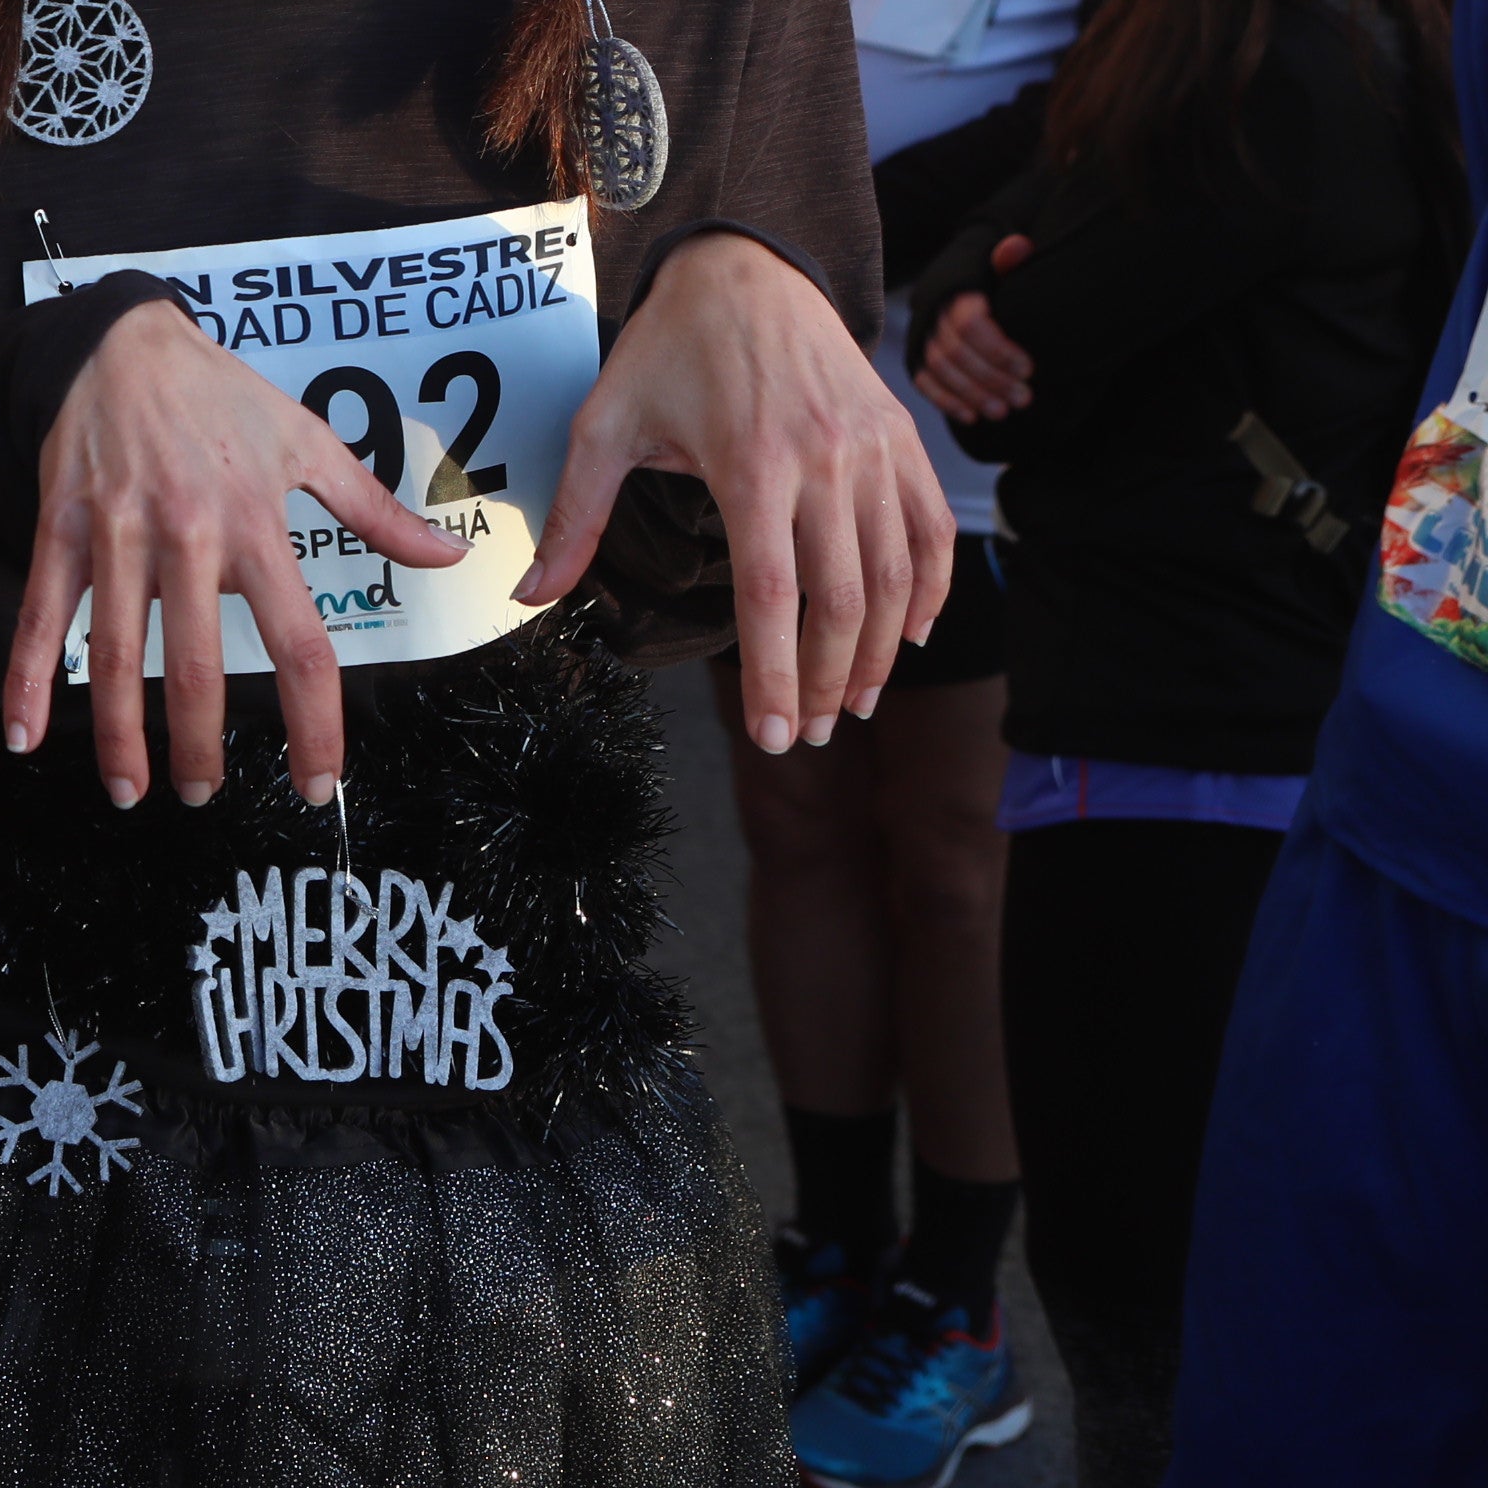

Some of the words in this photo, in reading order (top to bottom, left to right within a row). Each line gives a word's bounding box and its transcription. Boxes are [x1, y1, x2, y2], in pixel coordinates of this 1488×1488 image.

[232, 225, 565, 302] SILVESTRE
[331, 292, 410, 341] DE
[425, 261, 567, 330] CÁDIZ
[300, 350, 508, 508] 92
[235, 865, 454, 987] MERRY
[192, 966, 515, 1091] CHRISTMAS
